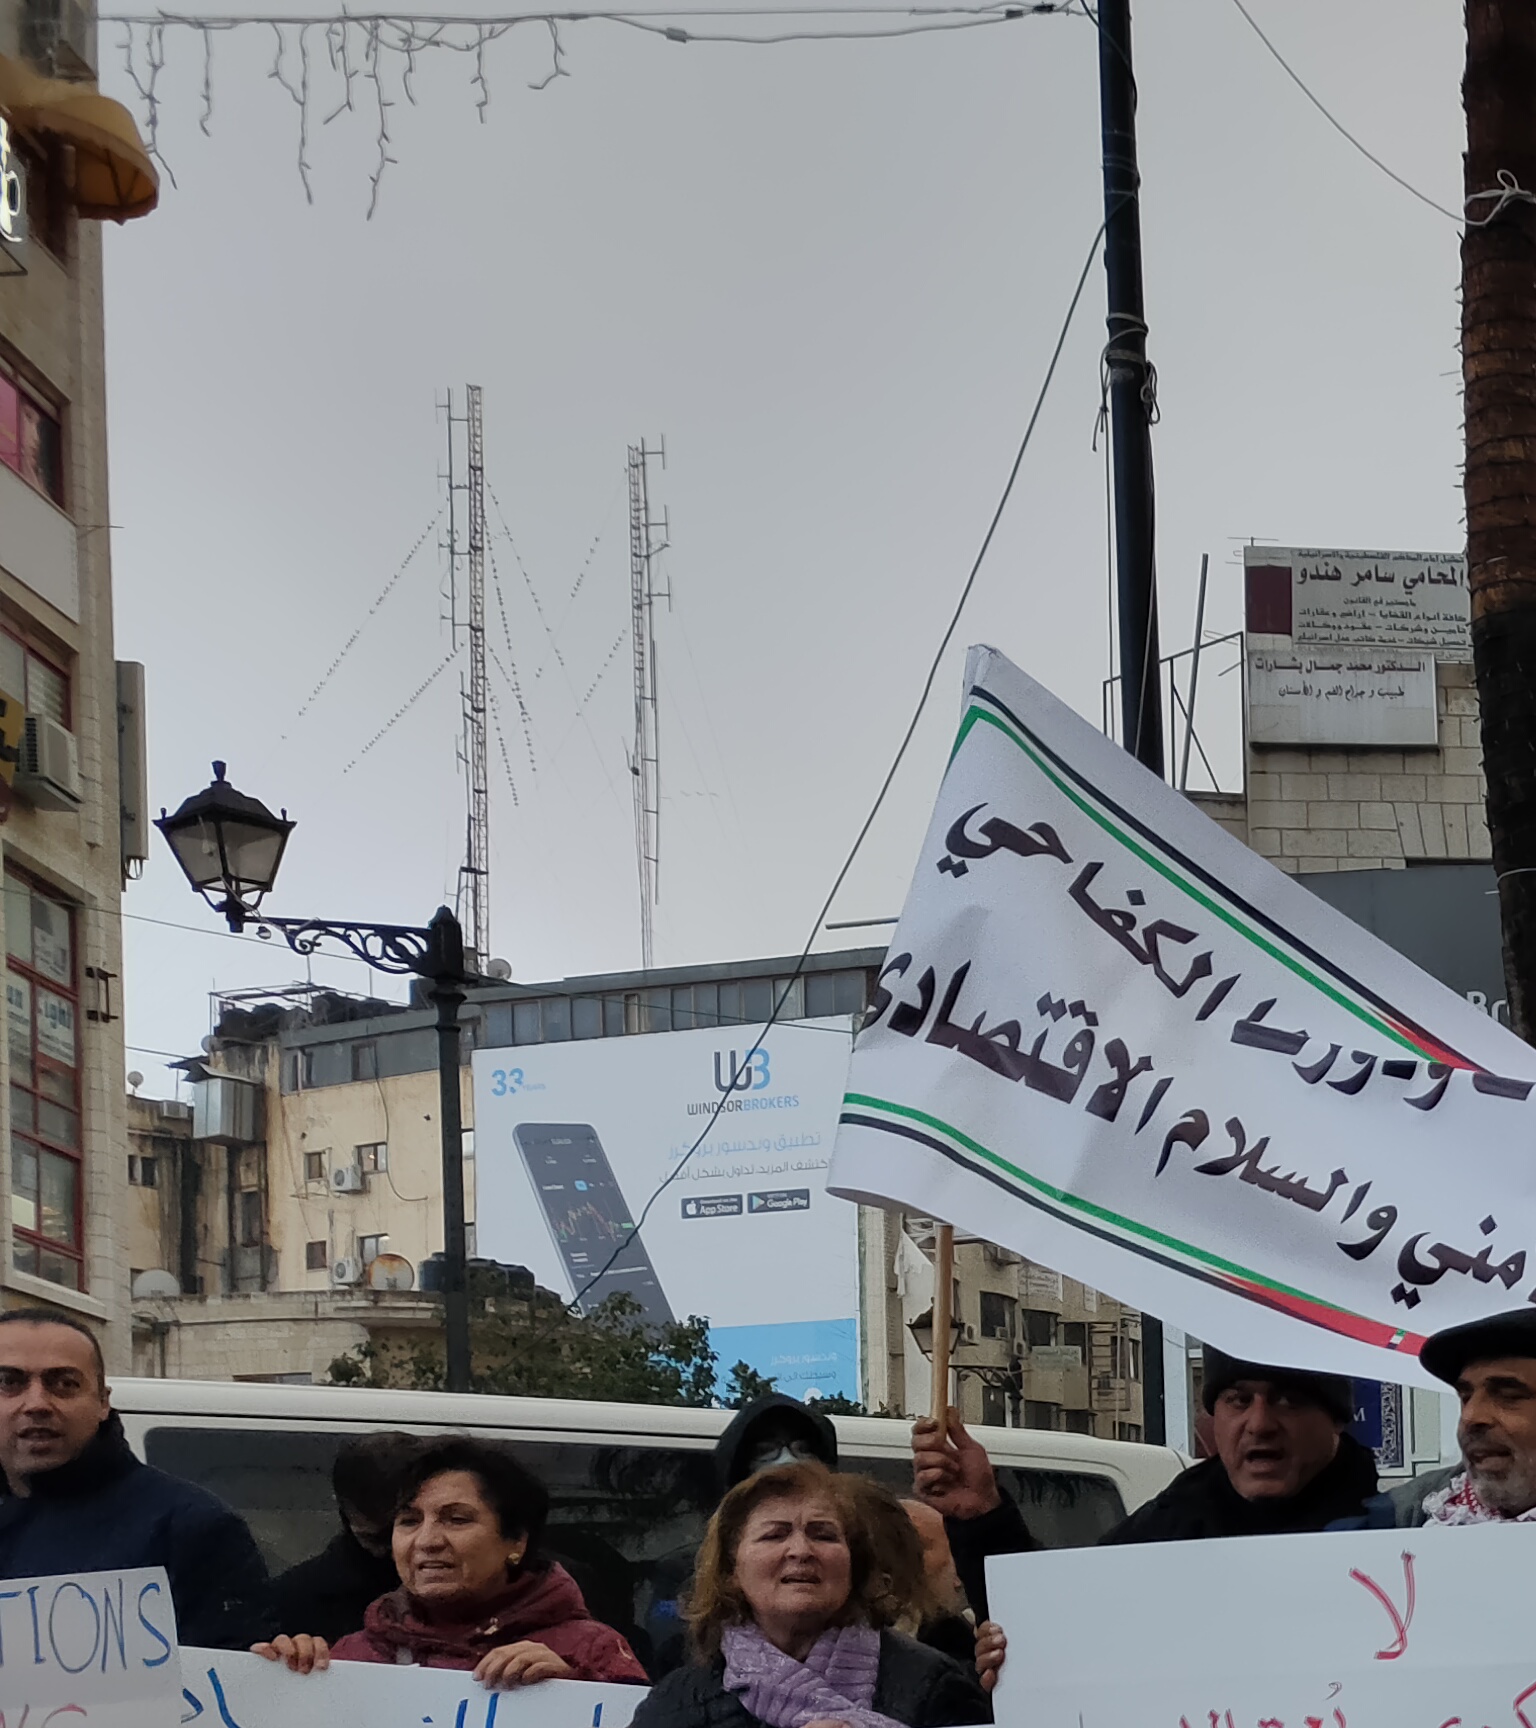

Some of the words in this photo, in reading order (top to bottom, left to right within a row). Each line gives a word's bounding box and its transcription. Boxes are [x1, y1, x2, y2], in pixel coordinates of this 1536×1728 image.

[1350, 563, 1395, 587] سامر
[1403, 564, 1464, 595] المحامي
[1305, 659, 1343, 675] جمال
[491, 1068, 525, 1097] 33
[1154, 1108, 1398, 1260] والسلام
[1349, 1549, 1416, 1660] لا
[0, 1578, 170, 1674] TIONS
